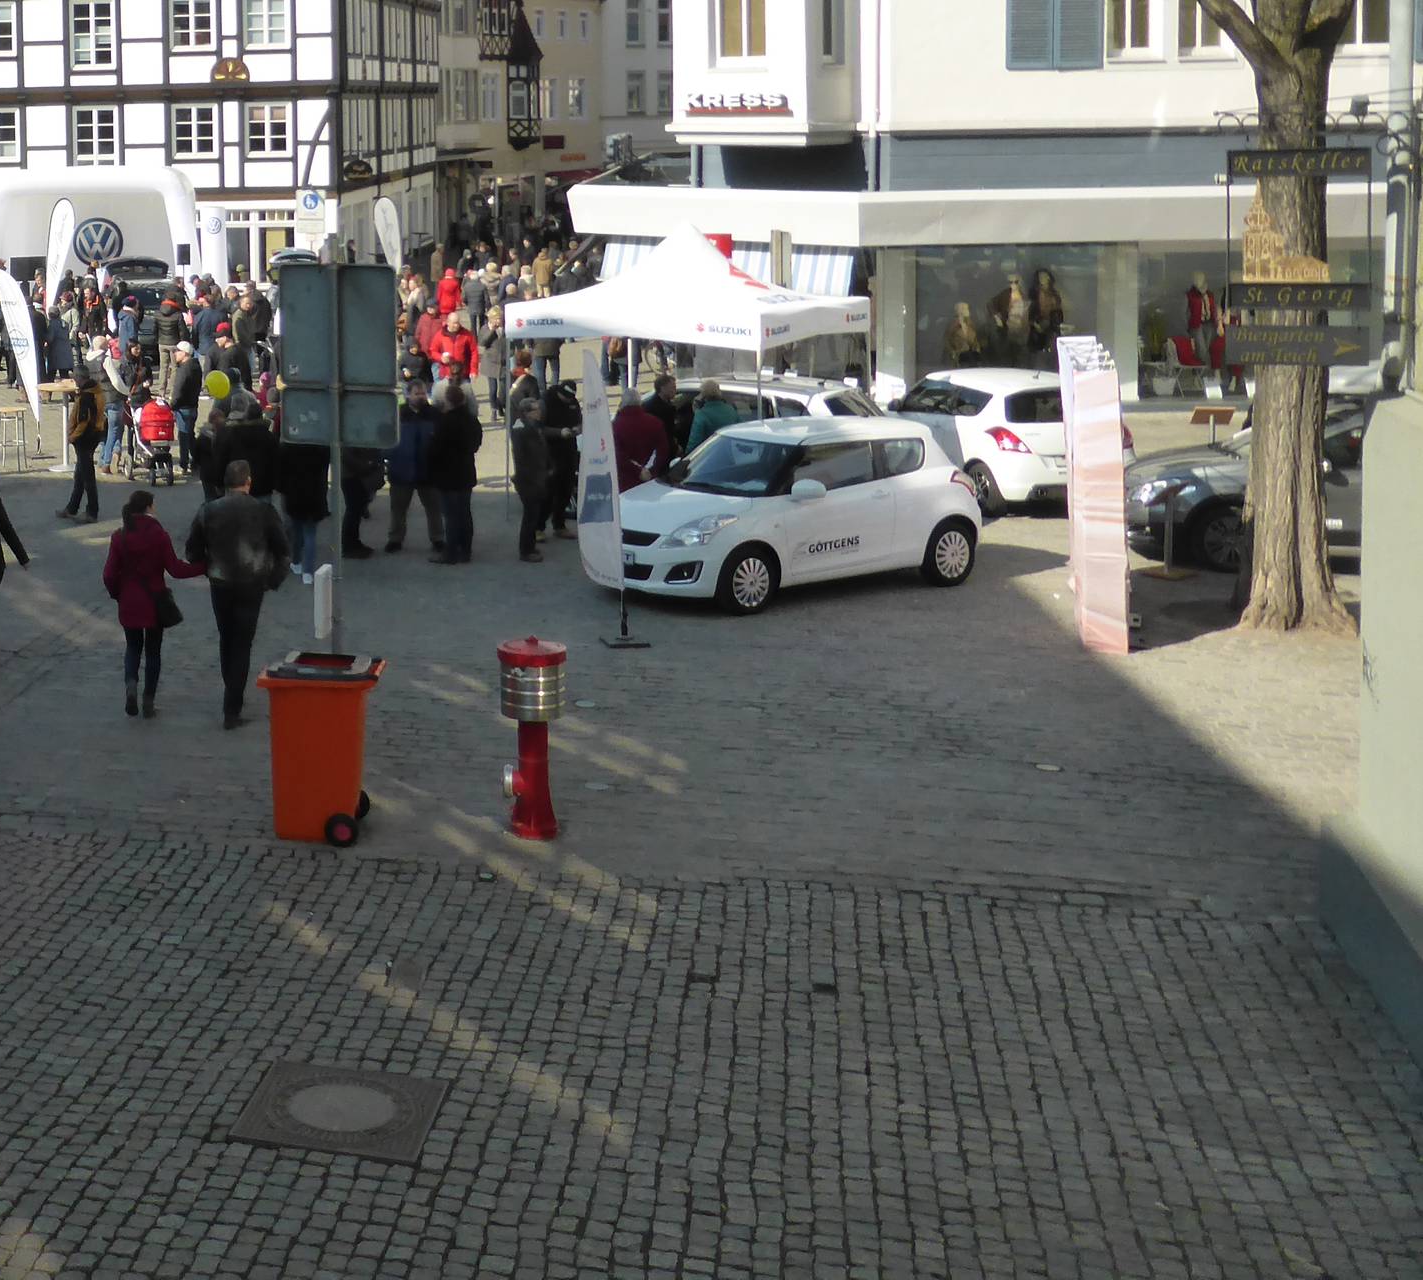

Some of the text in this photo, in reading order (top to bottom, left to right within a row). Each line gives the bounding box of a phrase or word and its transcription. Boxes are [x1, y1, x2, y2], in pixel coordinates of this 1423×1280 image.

[684, 93, 785, 109] KRESS
[1234, 151, 1365, 174] Ratskeller
[1278, 286, 1354, 308] Georg
[526, 318, 563, 326] SUZUKI
[708, 324, 752, 336] SUZUKI
[1235, 328, 1325, 344] Biergarten
[1240, 350, 1266, 362] am
[808, 535, 861, 554] GÖTTGENS
